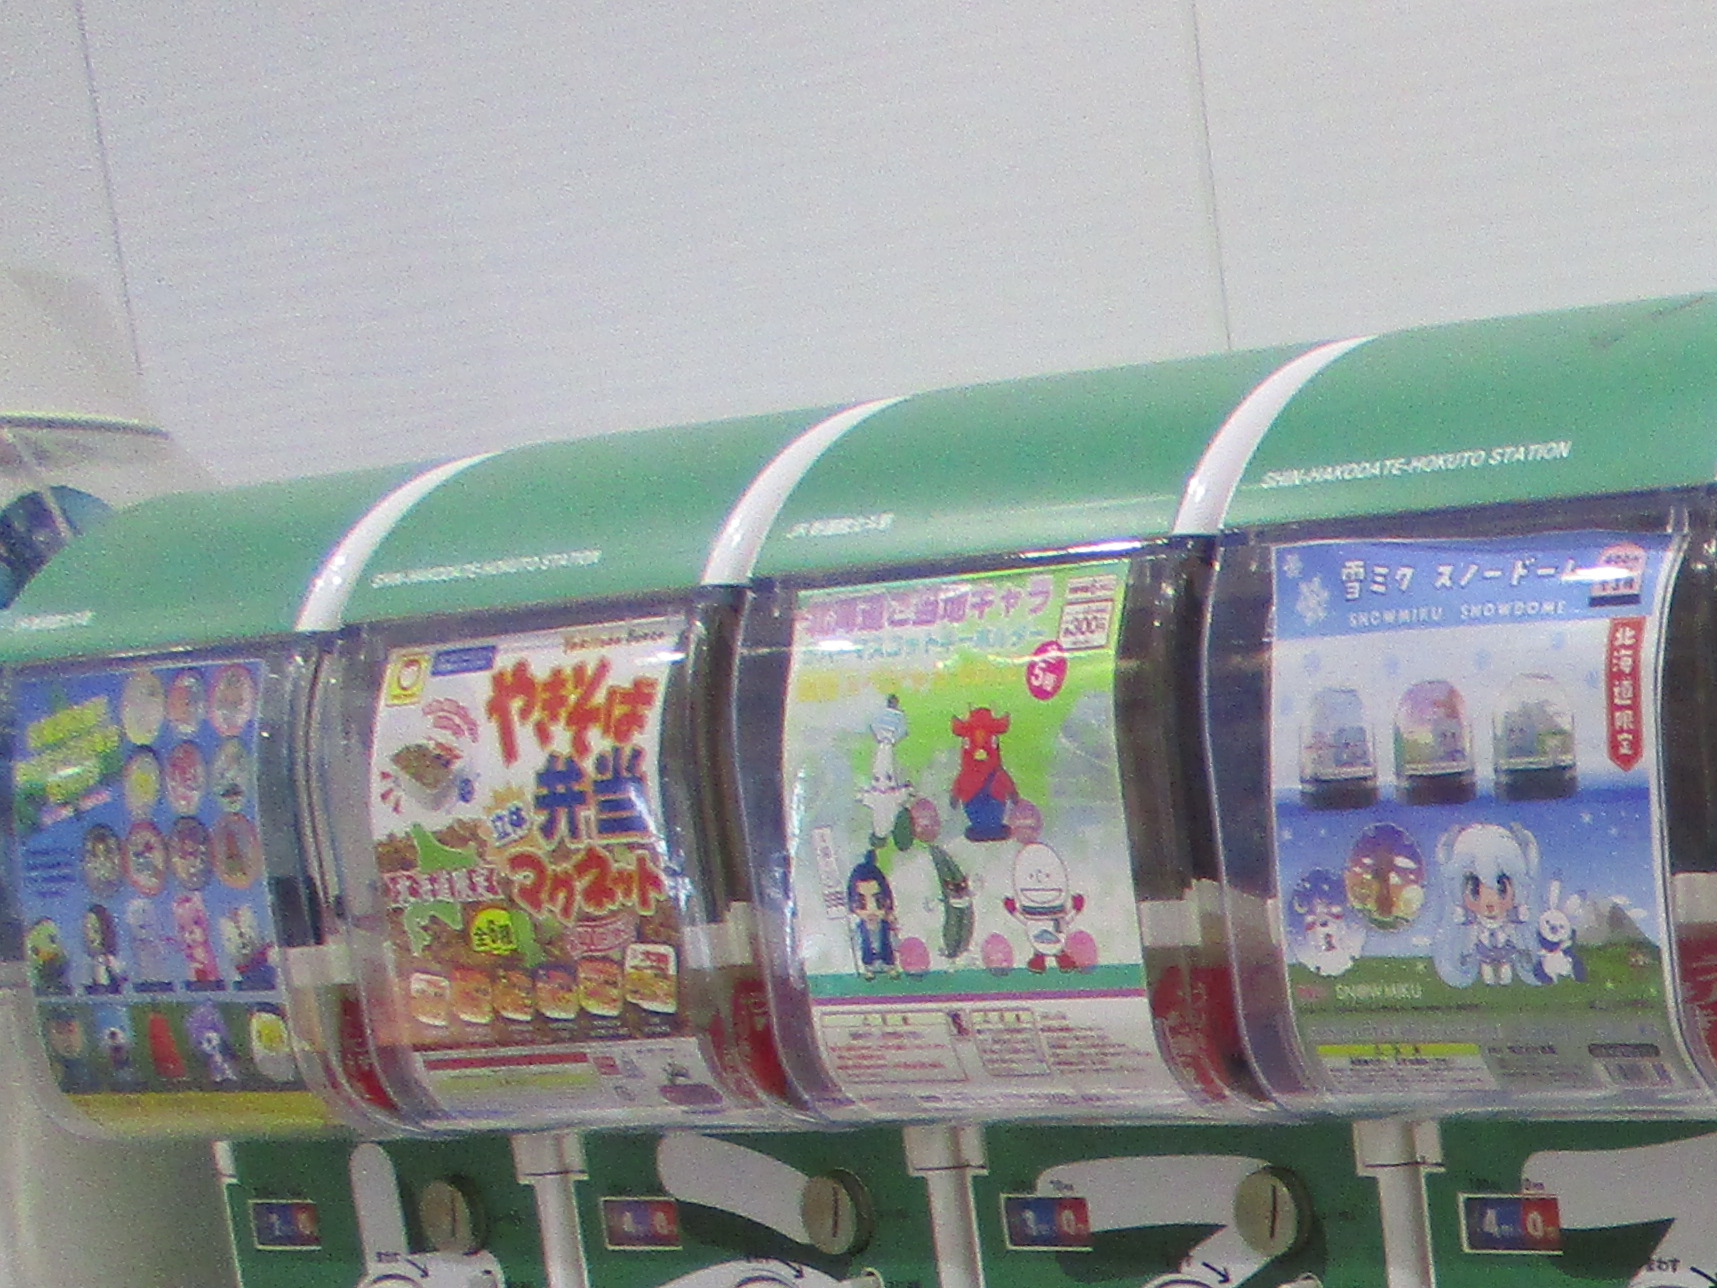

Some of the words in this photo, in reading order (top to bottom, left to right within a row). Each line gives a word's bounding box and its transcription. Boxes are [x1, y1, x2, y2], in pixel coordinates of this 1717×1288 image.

[1263, 449, 1484, 489] SHIN-HAKODATE-HOKUTO
[1490, 440, 1572, 464] STATION
[1340, 558, 1416, 602] 雪ミク
[486, 655, 660, 768] やきそば
[533, 744, 650, 841] 弁当
